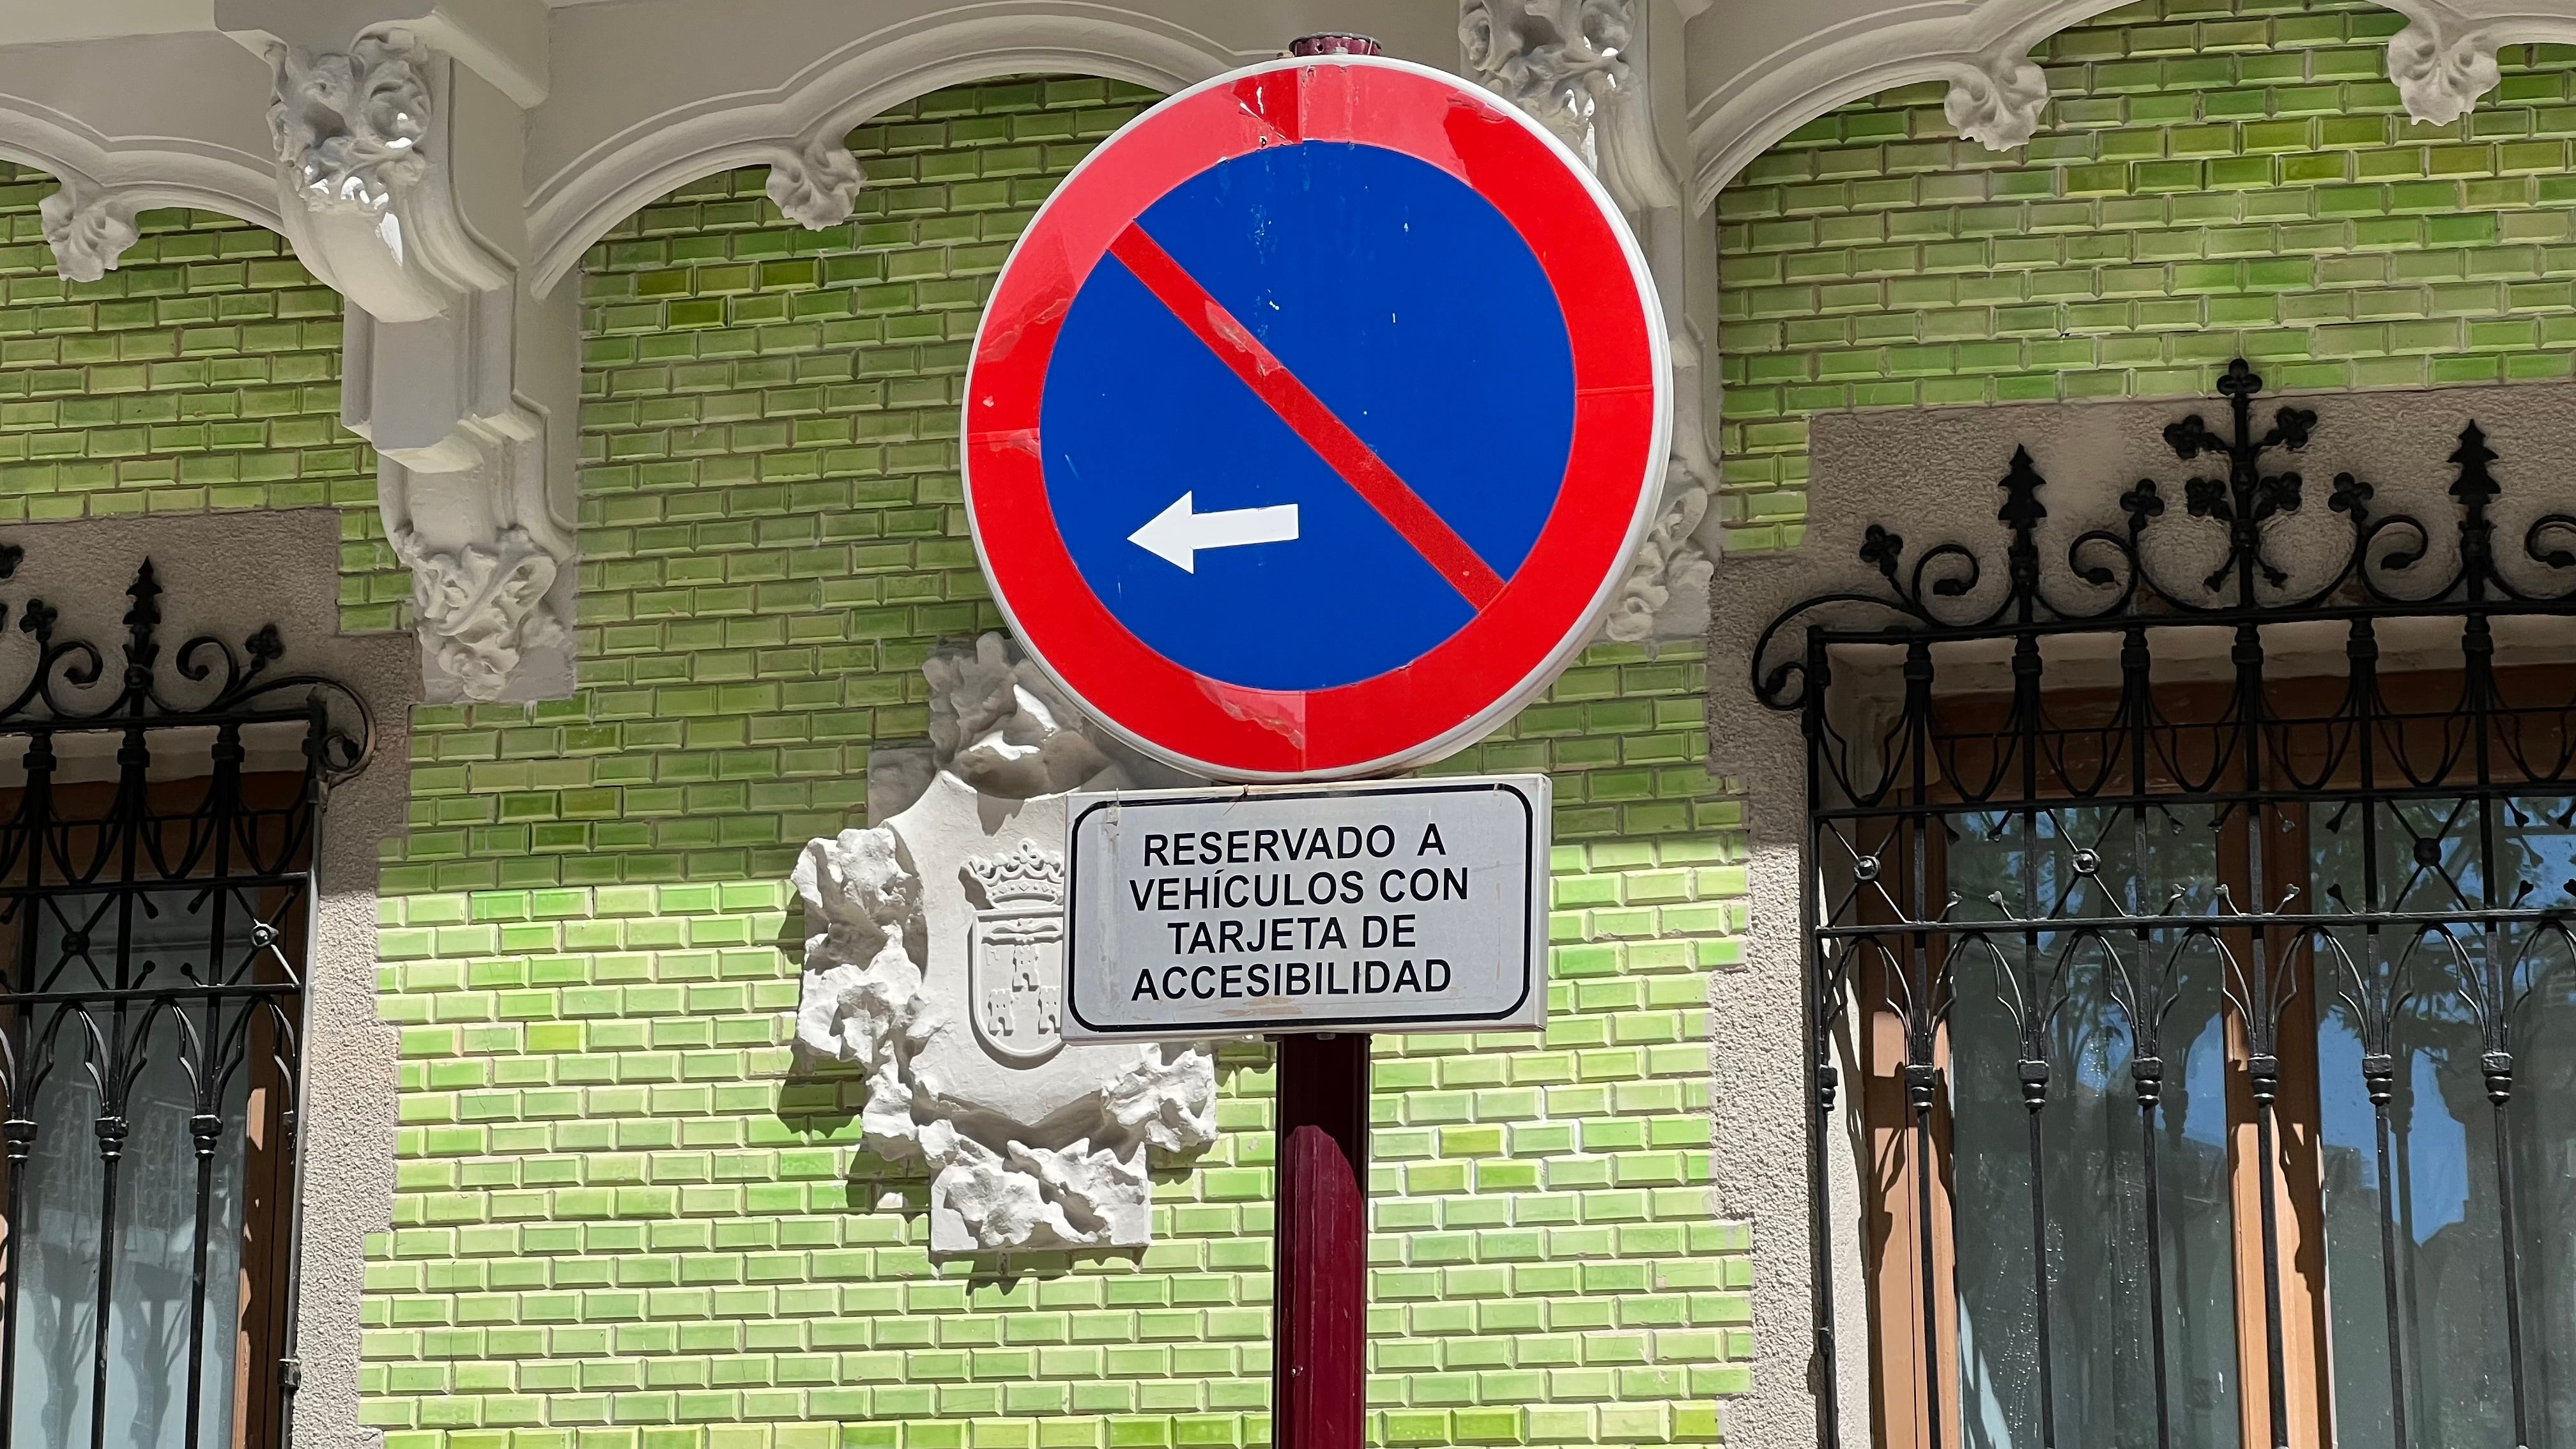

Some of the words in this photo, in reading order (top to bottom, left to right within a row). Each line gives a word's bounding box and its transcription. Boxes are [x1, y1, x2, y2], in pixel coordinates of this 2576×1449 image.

[1144, 825, 1395, 866] RESERVADO
[1417, 824, 1446, 855] A
[1130, 871, 1363, 910] VEHÍCULOS
[1380, 868, 1468, 902] CON
[1167, 917, 1347, 954] TARJETA
[1363, 914, 1415, 947] DE
[1131, 960, 1450, 1000] ACCESIBILIDAD
